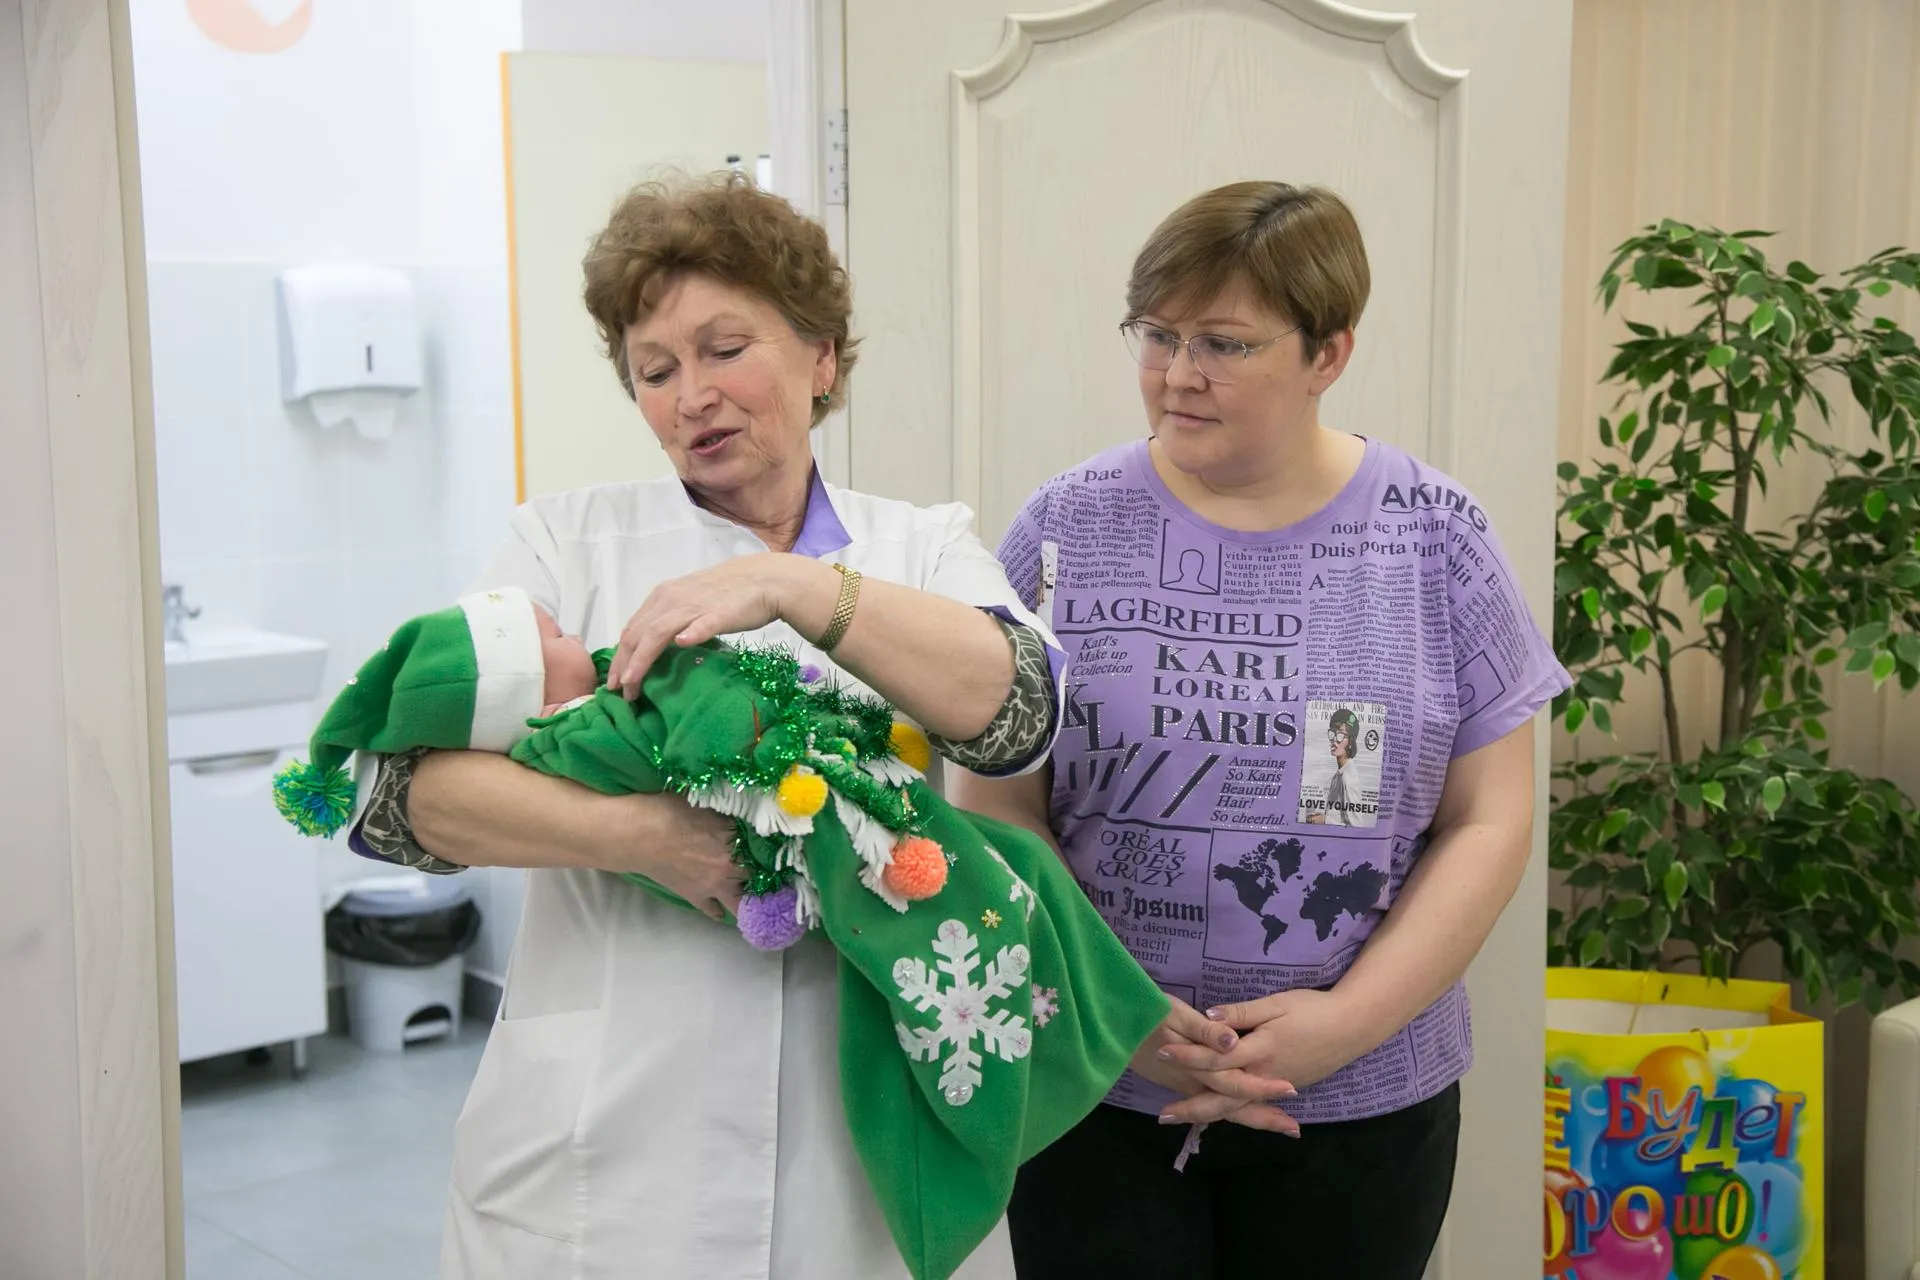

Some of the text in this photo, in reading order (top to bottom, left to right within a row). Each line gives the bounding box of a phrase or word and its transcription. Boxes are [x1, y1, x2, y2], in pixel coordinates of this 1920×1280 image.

[1381, 482, 1487, 533] AKING
[1373, 519, 1391, 533] ac
[1310, 542, 1355, 559] Duis
[1360, 541, 1406, 557] porta
[1071, 569, 1110, 582] egestas
[1263, 571, 1275, 579] sit
[1308, 573, 1327, 591] A
[1064, 597, 1302, 638] LAGERFIELD
[1082, 635, 1118, 650] Karl's
[1076, 648, 1127, 664] Make up
[1154, 643, 1299, 681] KARL
[1071, 663, 1133, 678] Collection
[1152, 676, 1299, 702] LOREAL
[1150, 704, 1297, 747] PARIS
[1228, 755, 1287, 770] Amazing
[1226, 768, 1283, 783] So Karis
[1220, 782, 1282, 797] Beautiful
[1216, 795, 1255, 809] Hair!
[1299, 799, 1379, 814] LOVE YOURSELF
[1210, 810, 1228, 822] So
[1112, 847, 1185, 870] GOES
[1095, 859, 1185, 888] KRAZY
[1136, 935, 1170, 952] taciti
[1201, 961, 1241, 975] Praesent
[1256, 968, 1290, 979] egestas
